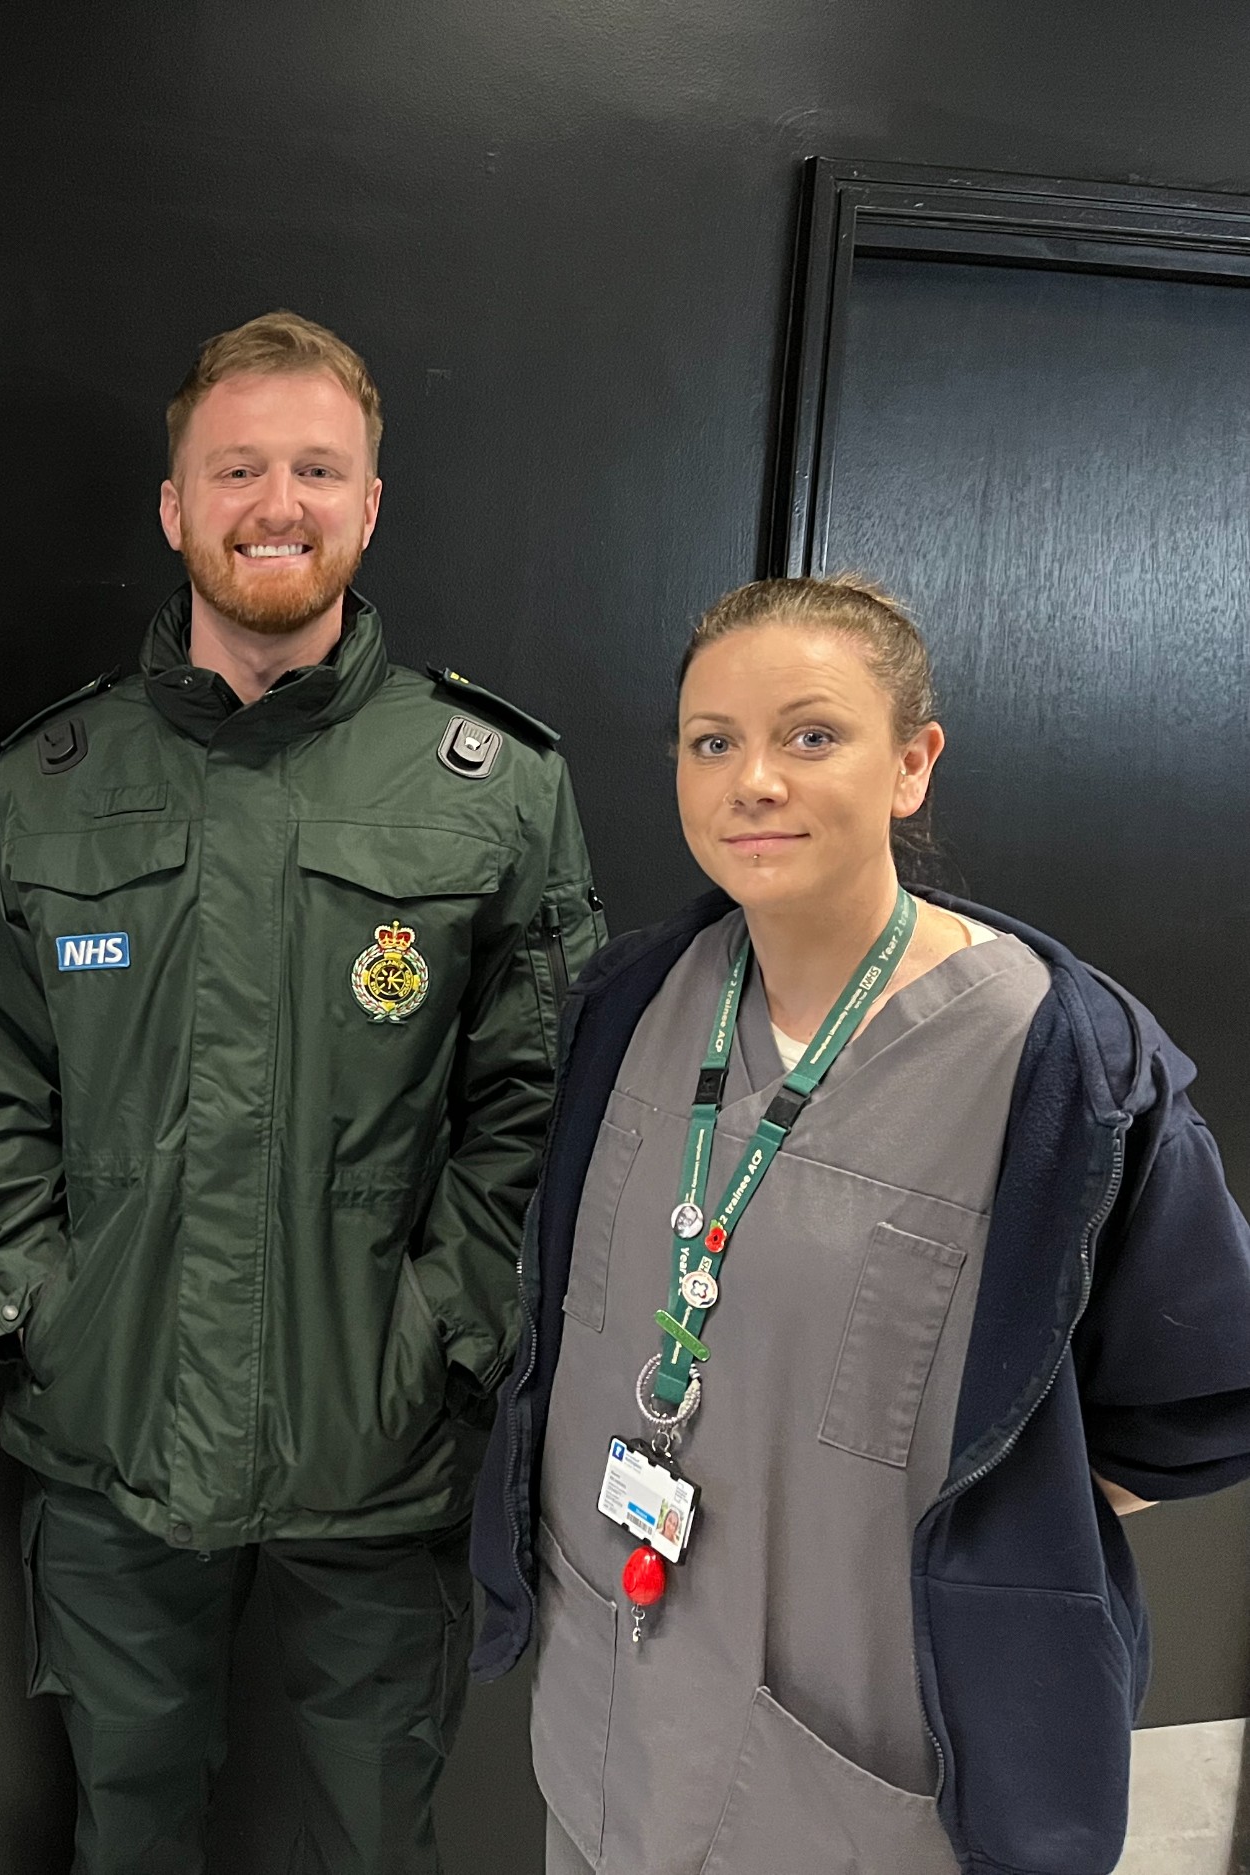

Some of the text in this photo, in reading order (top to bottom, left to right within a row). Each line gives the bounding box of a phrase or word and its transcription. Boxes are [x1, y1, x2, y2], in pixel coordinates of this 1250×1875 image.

[63, 937, 123, 967] NHS
[878, 935, 899, 961] Year
[894, 926, 904, 937] 2
[861, 967, 880, 989] NHS
[720, 990, 734, 1028] trainee
[715, 1029, 726, 1052] ACP
[719, 1149, 762, 1225] 2 trainee ACP
[679, 1247, 690, 1275] Year
